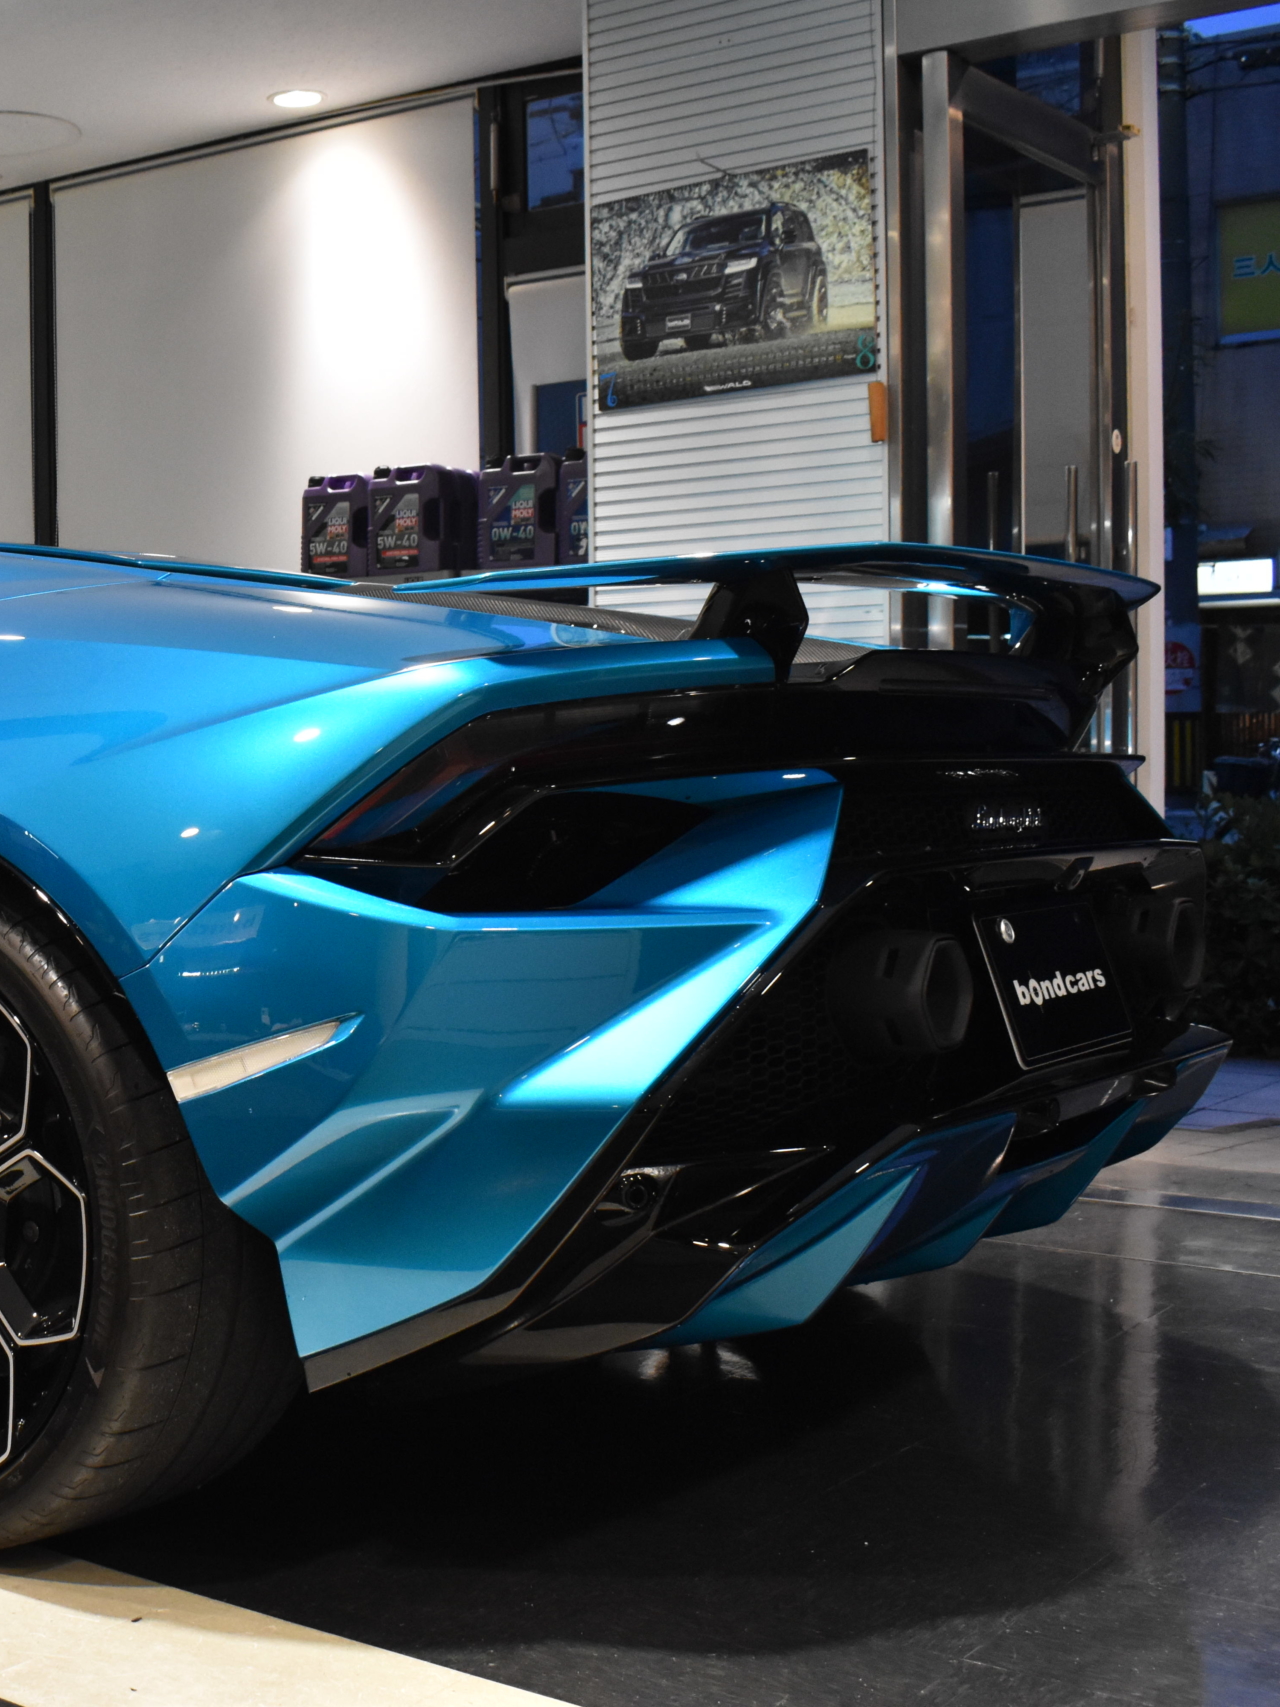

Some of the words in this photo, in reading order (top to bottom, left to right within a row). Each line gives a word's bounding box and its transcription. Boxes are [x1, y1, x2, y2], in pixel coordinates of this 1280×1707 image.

[856, 334, 876, 369] 8
[599, 372, 618, 407] 7
[512, 500, 533, 509] LIQUI
[395, 509, 417, 518] LIQUI
[511, 508, 533, 517] MOLY
[328, 517, 347, 525] LIQUI
[395, 517, 418, 527] MOLY
[327, 524, 347, 534] MOLY
[491, 525, 535, 541] 0W-40
[377, 534, 419, 549] 5W-40
[309, 541, 349, 556] 5W-40
[1013, 968, 1106, 1008] bondcars
